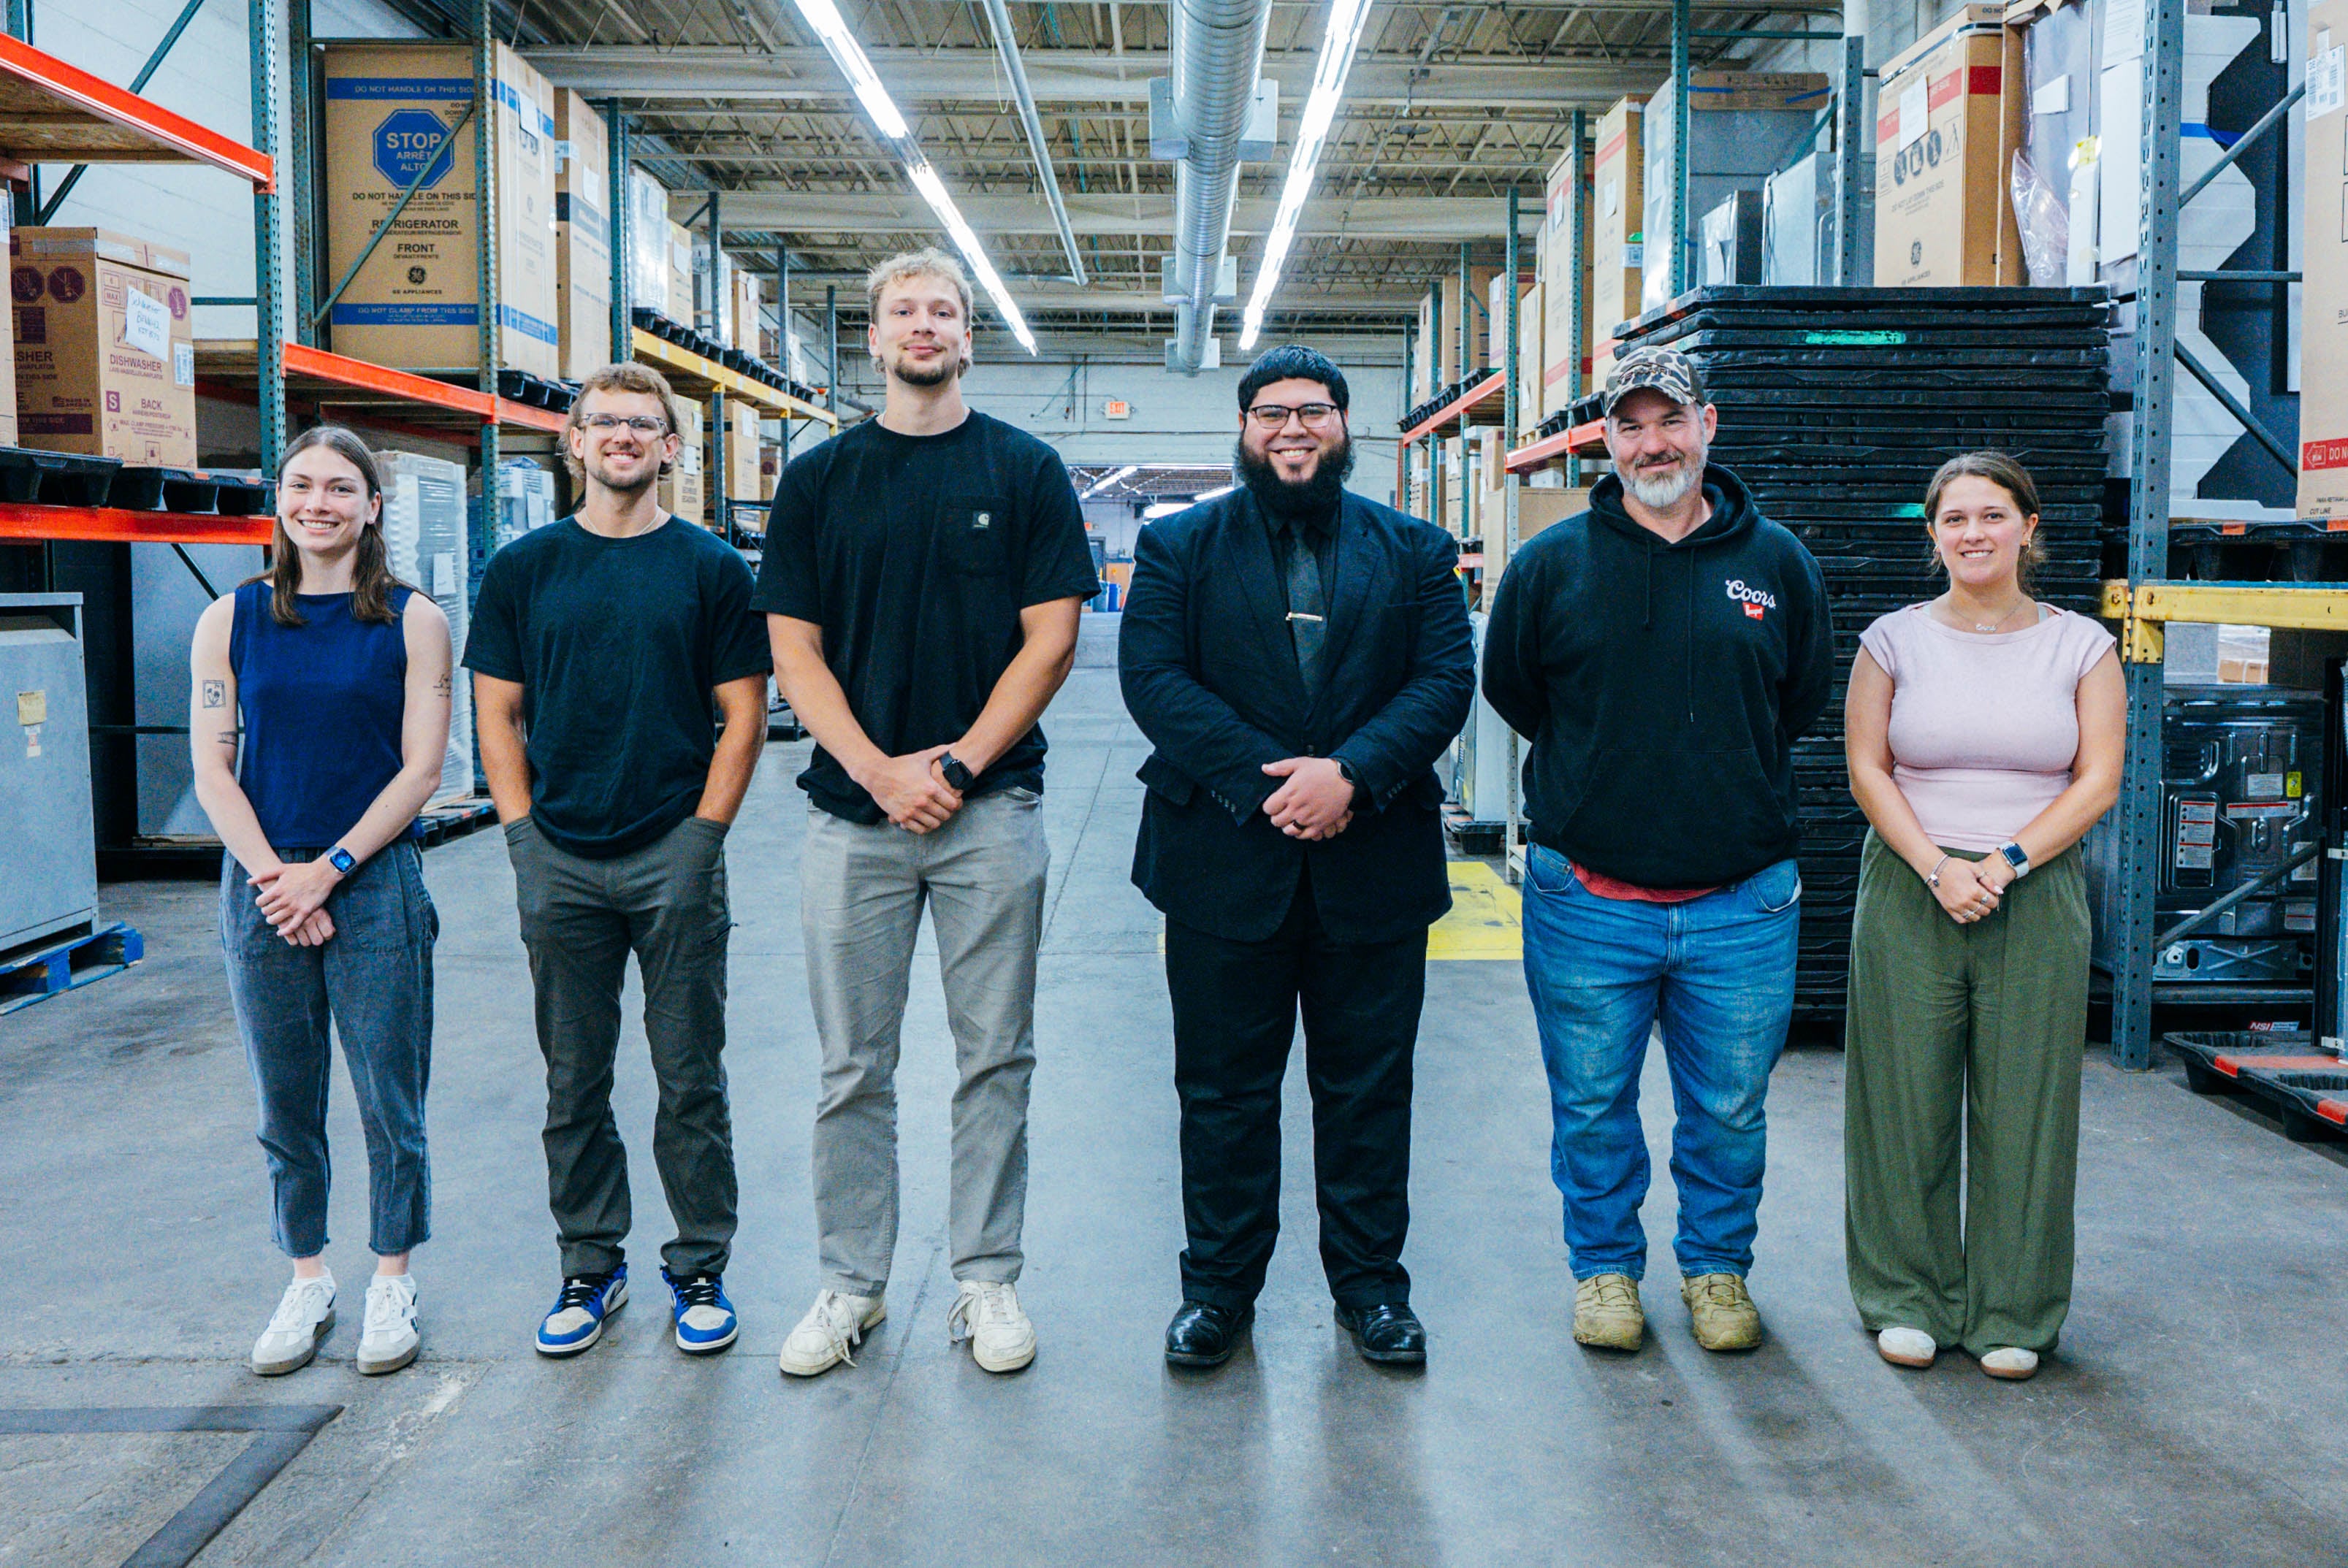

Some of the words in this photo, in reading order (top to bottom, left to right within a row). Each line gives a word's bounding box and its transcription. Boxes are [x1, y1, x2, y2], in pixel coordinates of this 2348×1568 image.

[354, 85, 367, 93] DO
[369, 85, 386, 93] NOT
[388, 85, 422, 93] HANDLE
[438, 85, 457, 94] THIS
[386, 132, 442, 149] STOP
[396, 149, 432, 161] ARRÊT
[352, 192, 365, 201] DO
[367, 192, 386, 201] NOT
[388, 192, 424, 201] HALE
[426, 192, 439, 201] ON
[441, 192, 461, 201] THIS
[463, 192, 476, 201] SID
[372, 220, 459, 229] RRIGERATOR
[397, 243, 435, 253] FRONT
[15, 351, 53, 362] SHER
[109, 353, 163, 372] DISHWASHER
[109, 393, 118, 410] S
[141, 397, 163, 411] BACK
[1110, 402, 1124, 414] EXIT
[2328, 447, 2341, 461] DO
[1725, 579, 1777, 609] Coors
[2249, 1022, 2271, 1030] NSI
